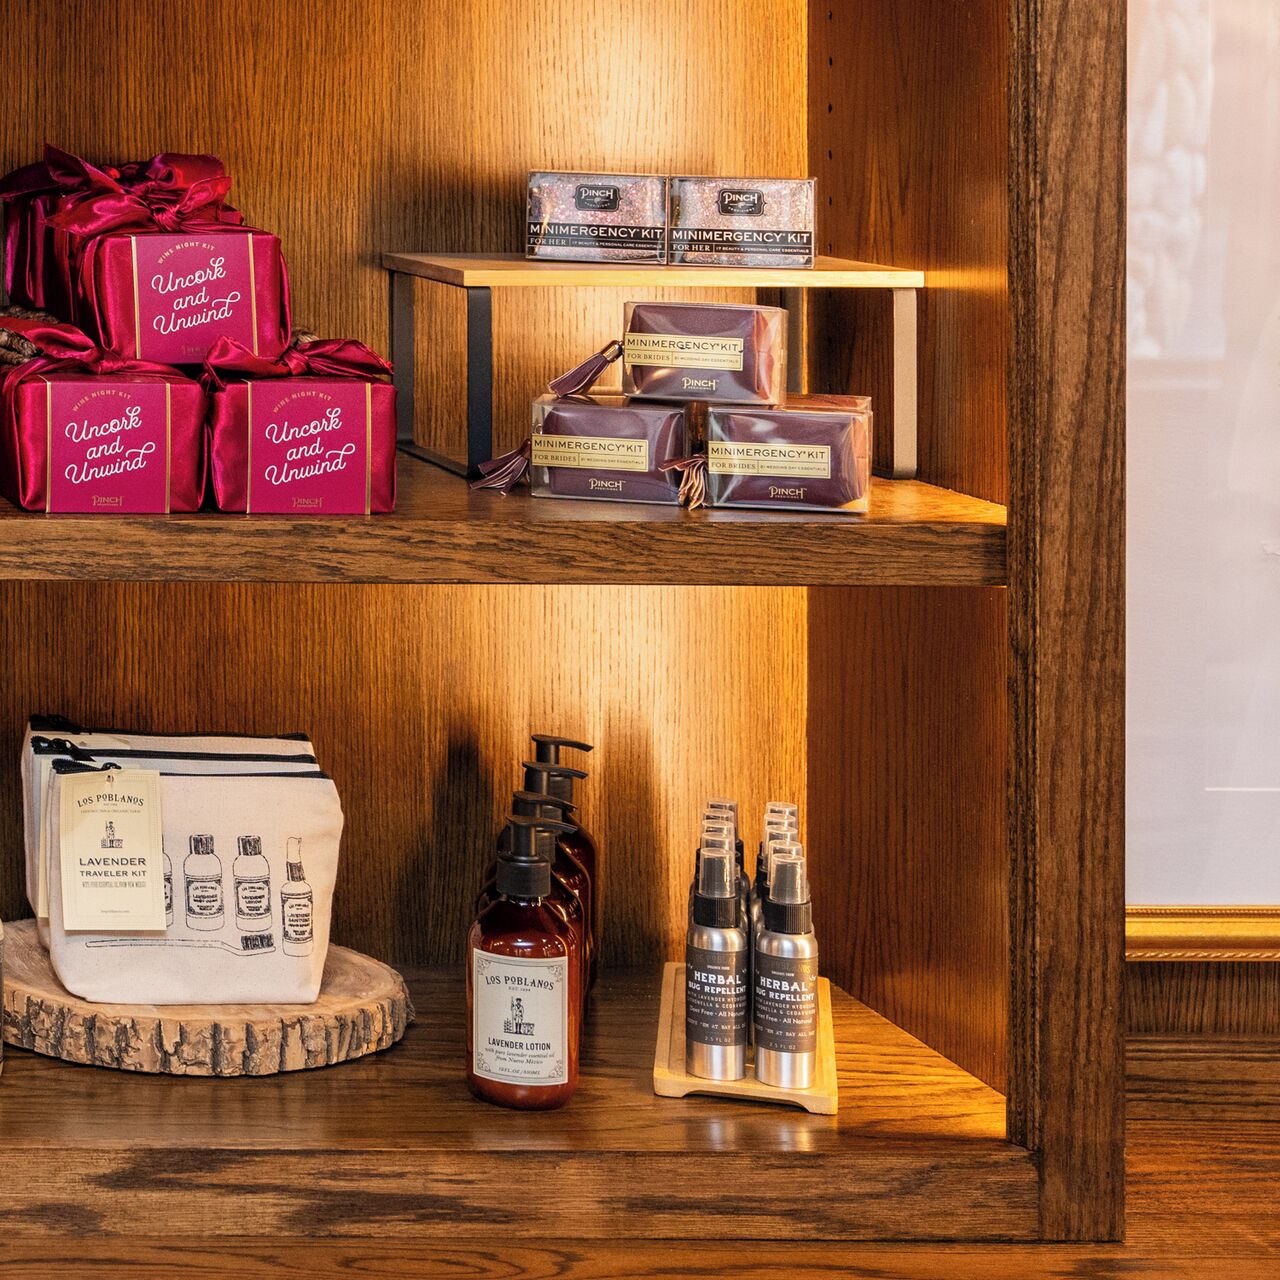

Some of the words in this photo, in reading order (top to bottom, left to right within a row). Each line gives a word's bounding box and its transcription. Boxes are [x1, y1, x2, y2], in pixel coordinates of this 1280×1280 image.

[580, 187, 613, 199] PINCH
[723, 192, 759, 204] PINCH
[530, 224, 638, 238] MINIMERGENCY
[641, 228, 663, 239] KIT
[672, 230, 783, 243] MINIMERGENCY
[787, 232, 810, 243] KIT
[158, 248, 174, 264] WINE
[175, 242, 199, 252] NIGHT
[202, 242, 216, 252] KIT
[151, 256, 226, 294] Uncork
[173, 287, 209, 311] and
[153, 291, 240, 335] Unwind
[627, 338, 716, 350] MINIMERGENCY
[720, 343, 738, 352] KIT
[682, 377, 716, 389] PINCH
[65, 406, 142, 442] Uncork
[265, 407, 342, 444] Uncork
[86, 436, 124, 460] and
[286, 438, 323, 461] and
[534, 440, 620, 451] MINIMERGENCY
[625, 444, 644, 452] KIT
[711, 446, 803, 458] MINIMERGENCY
[808, 451, 826, 459] KIT
[65, 441, 156, 485] Unwind
[265, 442, 356, 486] Unwind
[589, 478, 622, 490] PINCH
[769, 486, 804, 498] PINCH
[77, 795, 94, 808] LOS
[96, 793, 145, 808] POBLANOS
[79, 857, 146, 866] LAVENDER
[80, 869, 128, 877] TRAVELER
[131, 869, 147, 877] KIT
[485, 975, 501, 985] LOS
[504, 975, 554, 991] POBLANOS
[694, 971, 741, 984] HERBAL
[688, 981, 700, 990] BUG
[704, 985, 746, 994] REPELLENT
[488, 1037, 523, 1050] LAVENDER
[525, 1043, 551, 1051] LOTION
